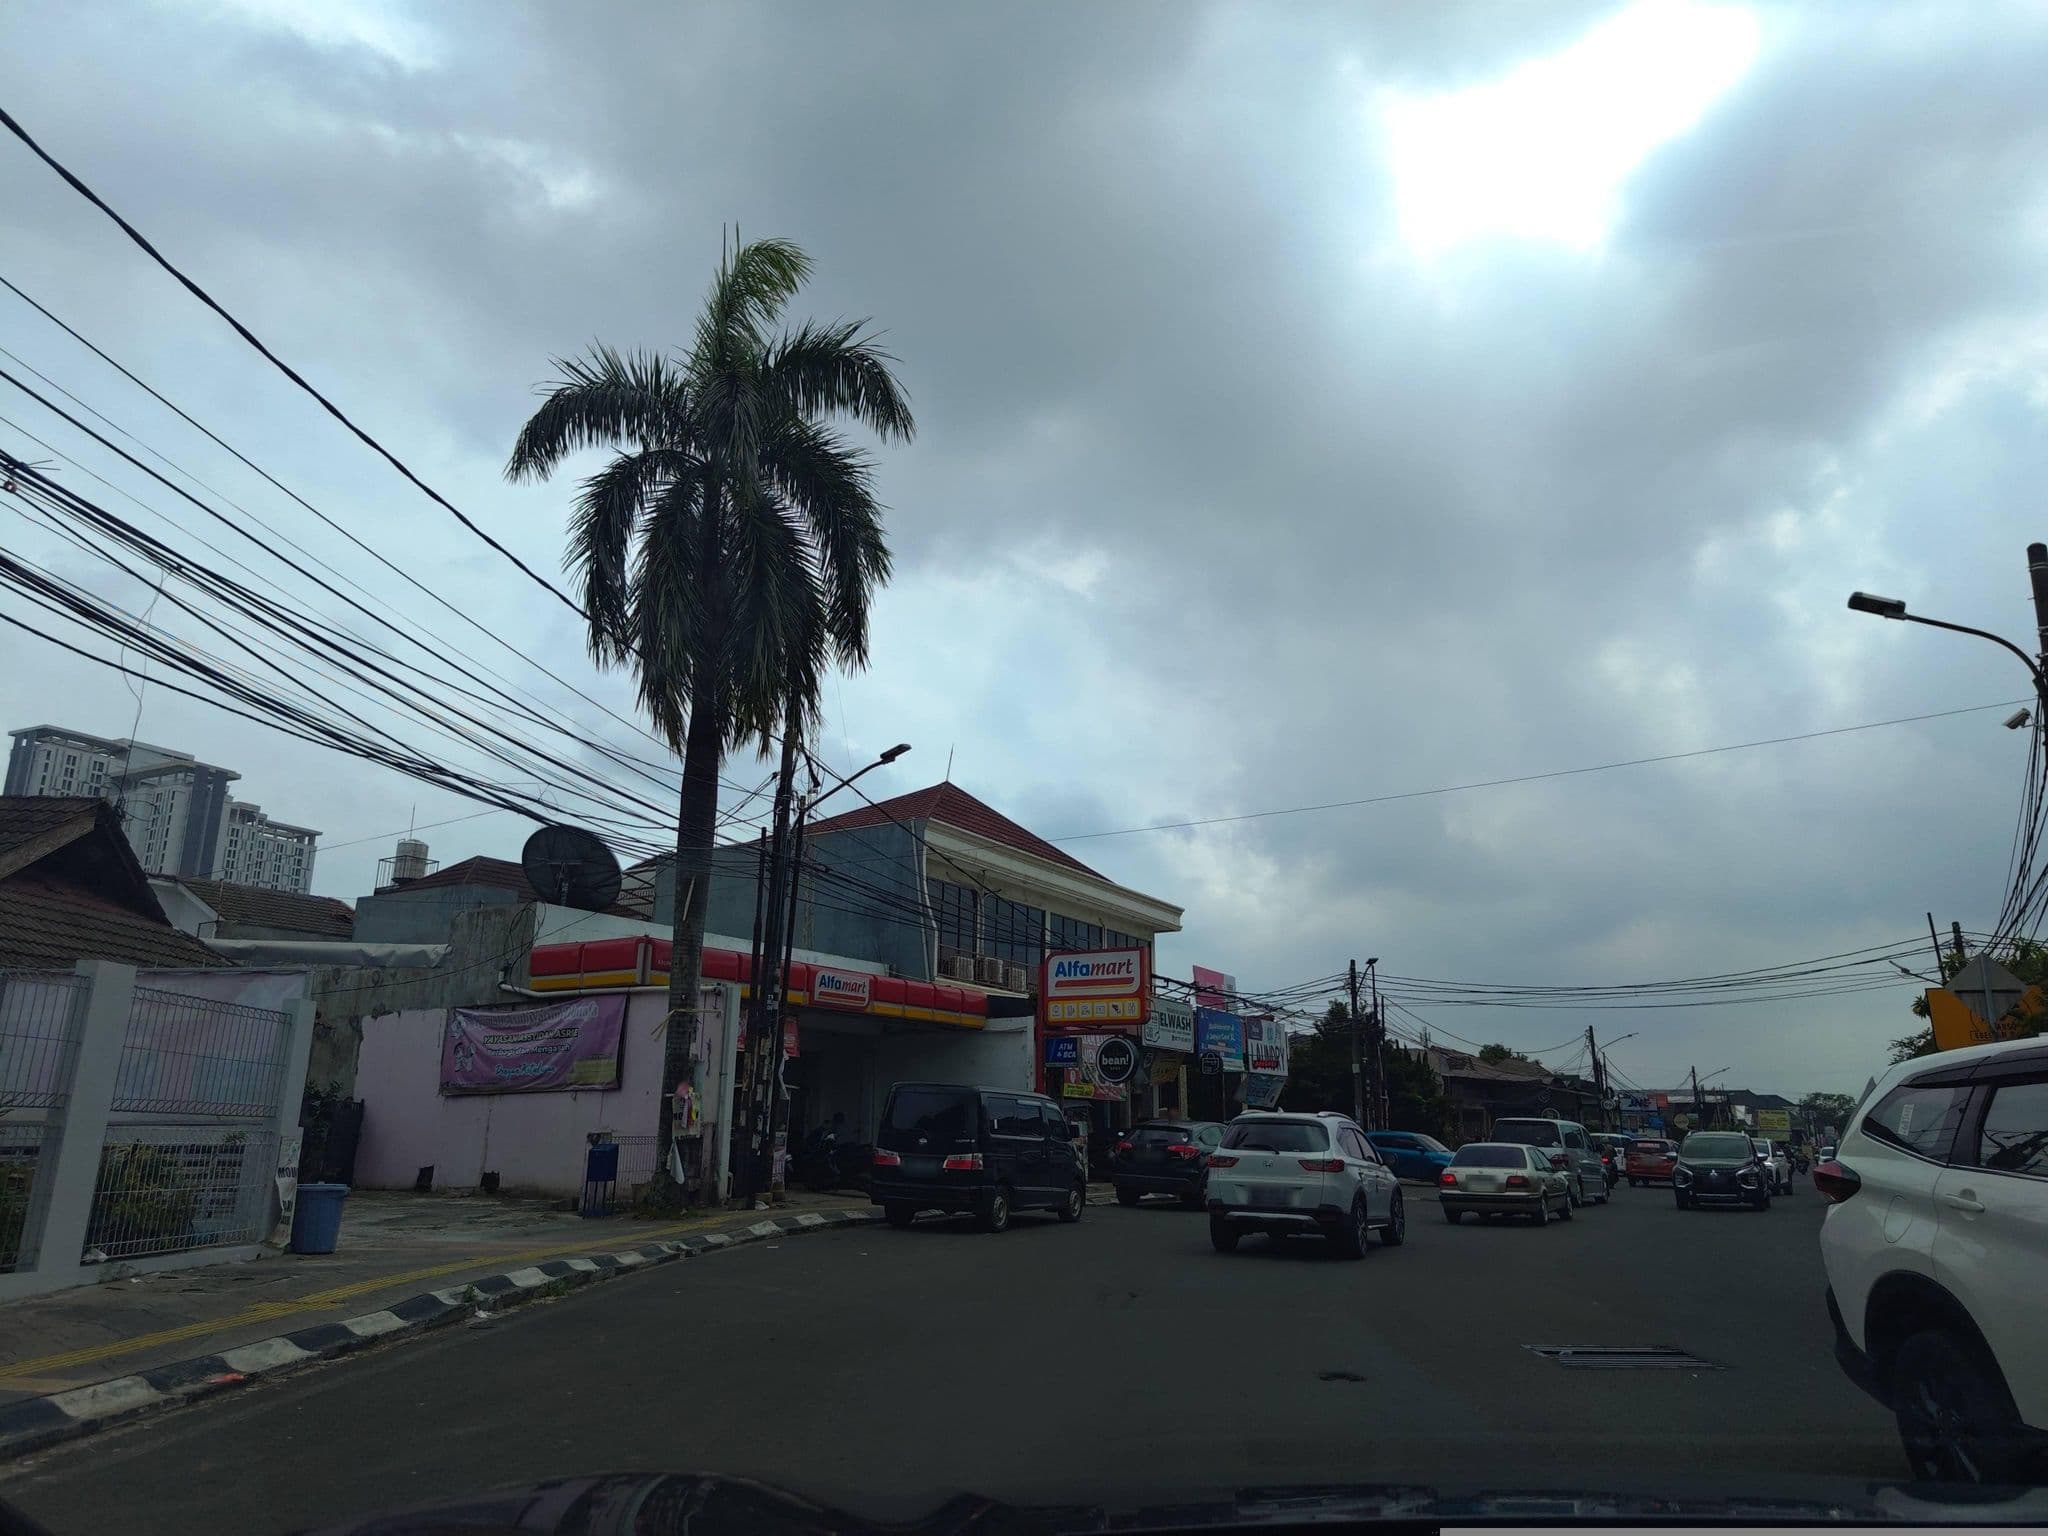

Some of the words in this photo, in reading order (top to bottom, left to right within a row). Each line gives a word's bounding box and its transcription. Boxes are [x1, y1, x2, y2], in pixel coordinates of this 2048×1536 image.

[1055, 958, 1134, 978] Alfamart
[819, 974, 866, 994] Alfamart
[1058, 1042, 1074, 1051] ATM
[1063, 1050, 1077, 1058] BCA
[1101, 1053, 1130, 1066] bean!
